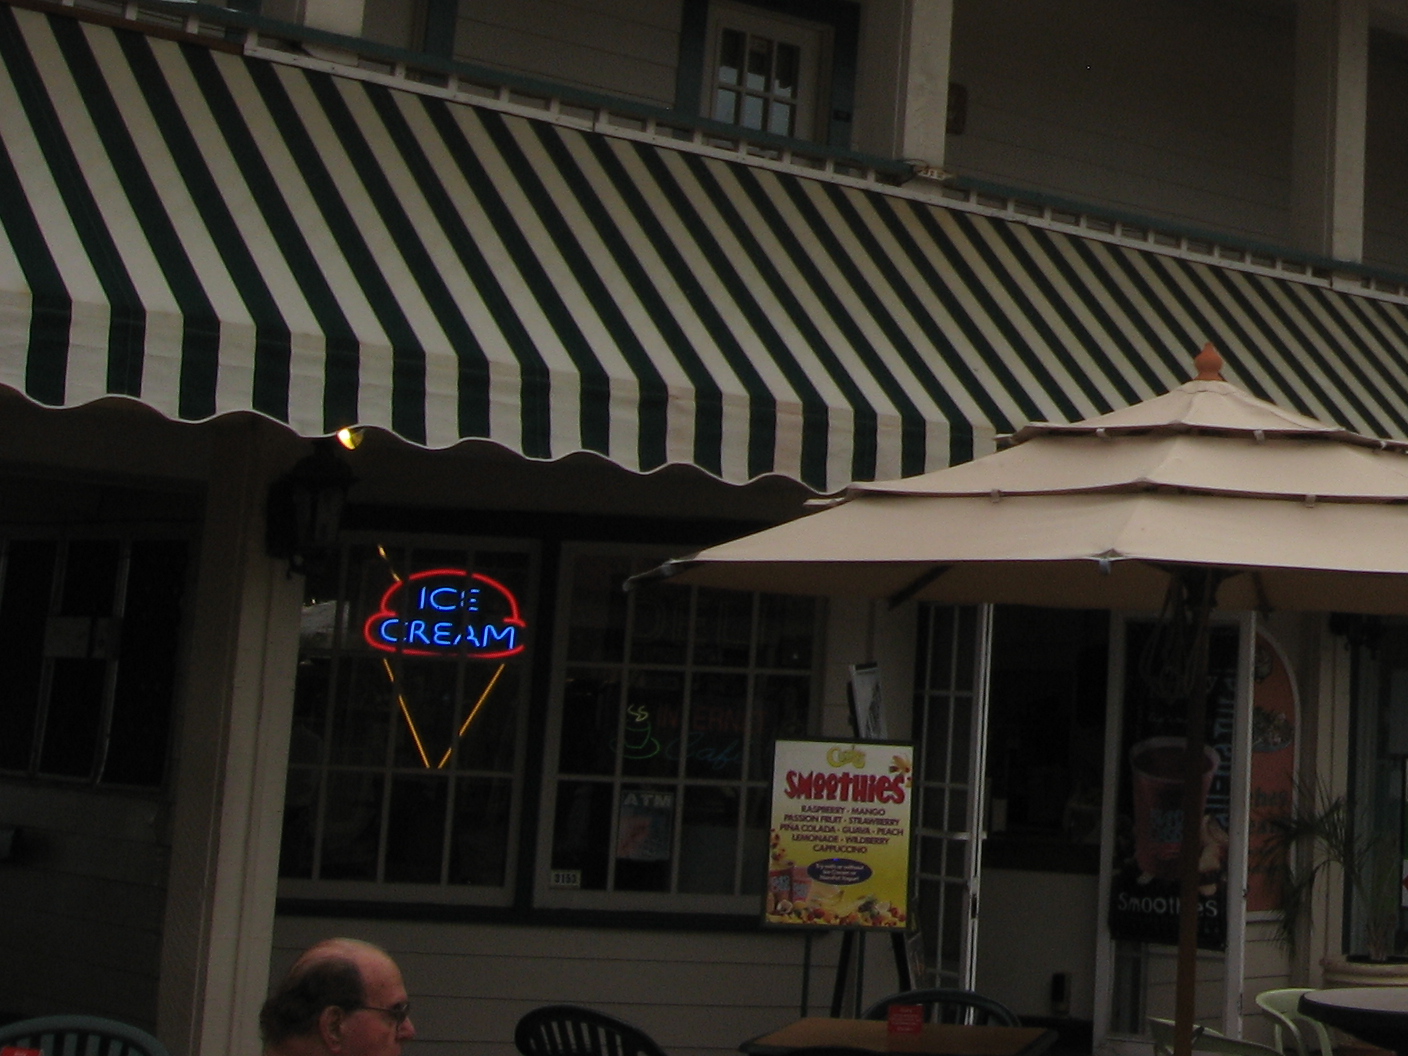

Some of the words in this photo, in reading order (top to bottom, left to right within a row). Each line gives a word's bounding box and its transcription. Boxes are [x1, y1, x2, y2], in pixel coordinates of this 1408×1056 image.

[418, 587, 480, 611] ICE
[379, 618, 516, 650] CREAM
[624, 793, 671, 808] ATM
[801, 805, 846, 814] RASPBERRY
[851, 807, 886, 816] MANGO
[784, 814, 818, 823] PASSION
[820, 816, 843, 824] FRUIT
[849, 817, 900, 826] STRAWBERRY
[801, 824, 836, 833] COLADA
[842, 826, 870, 835] GUAVA
[877, 828, 904, 836] PEACH
[792, 834, 839, 843] LEMONADE
[813, 844, 868, 854] CAPPUCCINO
[1117, 891, 1219, 918] Smootes
